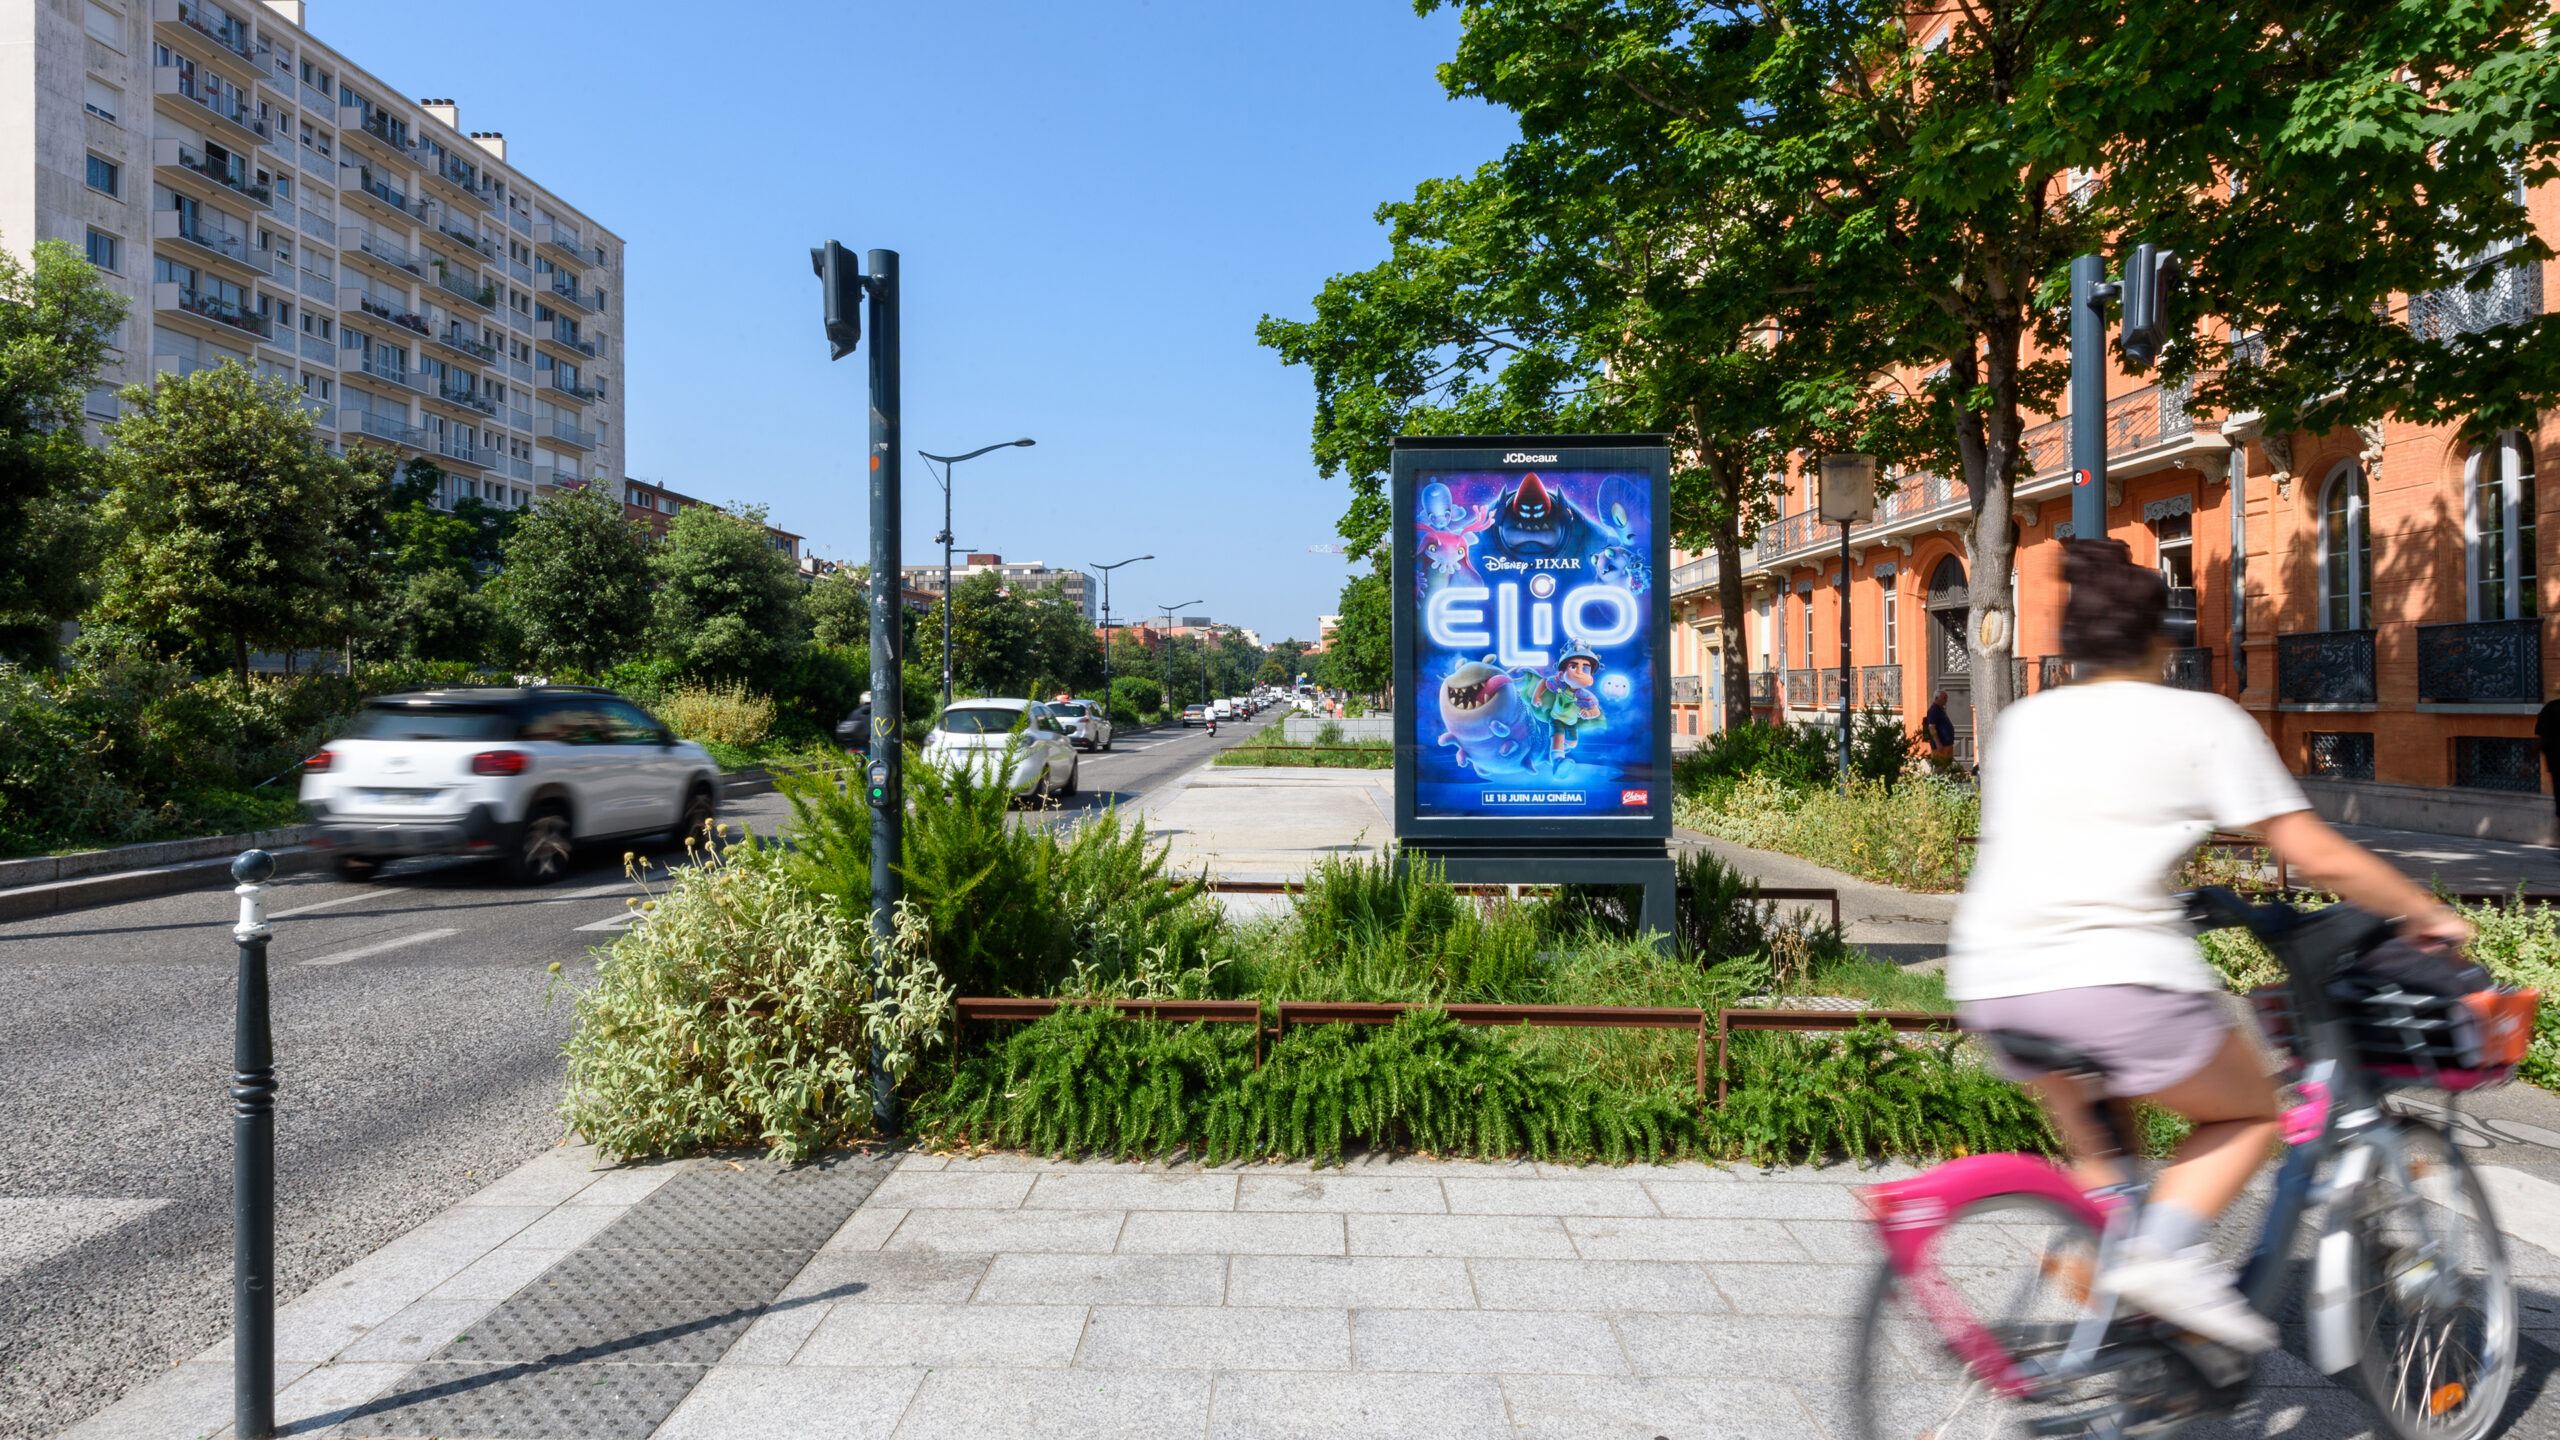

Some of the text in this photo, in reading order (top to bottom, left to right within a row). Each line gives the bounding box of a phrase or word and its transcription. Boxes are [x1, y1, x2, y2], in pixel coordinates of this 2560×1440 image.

[1502, 453, 1558, 463] JCDecaux
[2075, 472, 2083, 484] 8
[1482, 555, 1581, 575] Disney PIXAR
[1485, 792, 1583, 802] LE 18 JUIN AU CINÉMA
